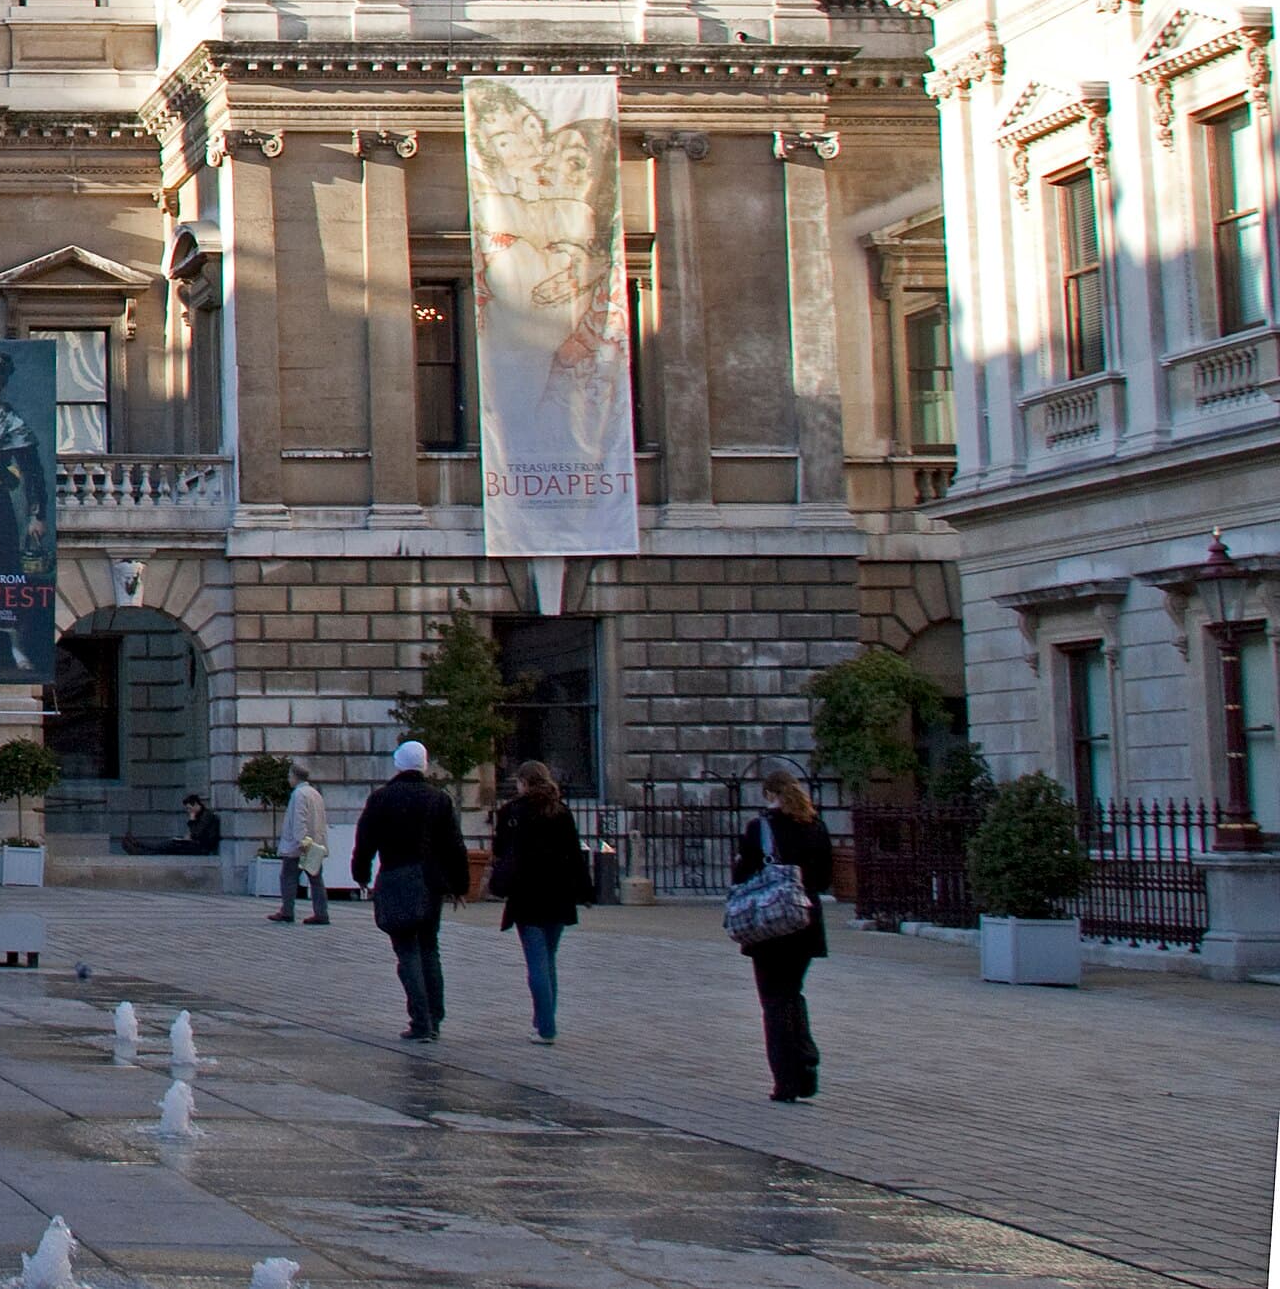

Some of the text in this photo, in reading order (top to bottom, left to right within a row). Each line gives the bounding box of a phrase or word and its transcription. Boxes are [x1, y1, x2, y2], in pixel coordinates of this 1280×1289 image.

[507, 462, 605, 473] TREASURES FROM
[485, 471, 633, 496] BUDAPEST
